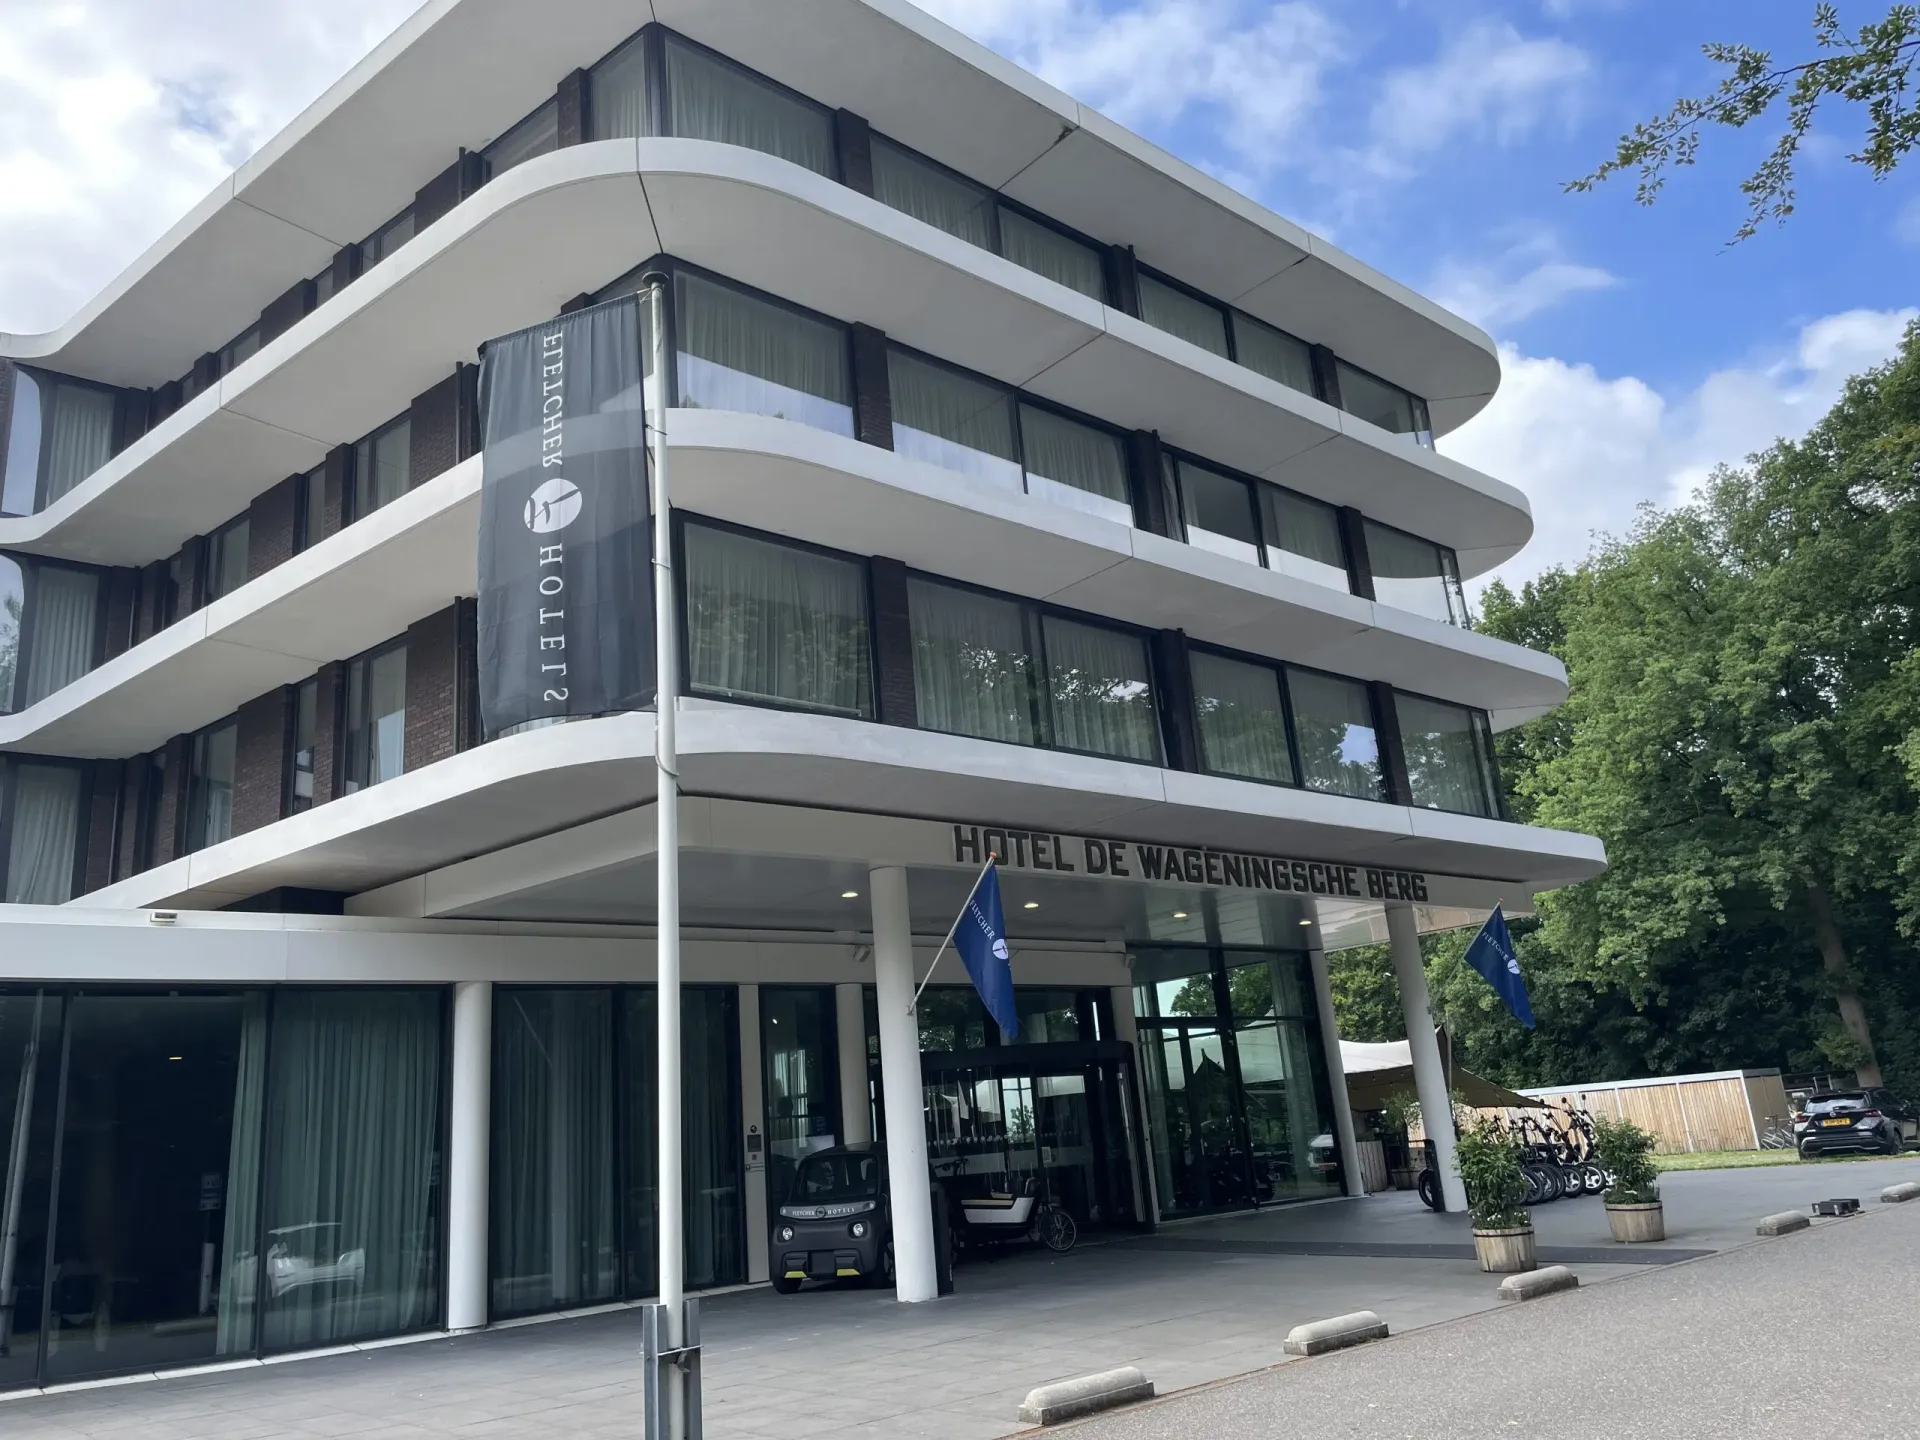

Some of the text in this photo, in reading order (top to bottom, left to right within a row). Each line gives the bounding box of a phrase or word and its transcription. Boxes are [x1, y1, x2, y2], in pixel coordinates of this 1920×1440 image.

[954, 825, 1428, 902] HOTEL DE WAGENINGSCHE BERG
[827, 1207, 855, 1215] HOTELS
